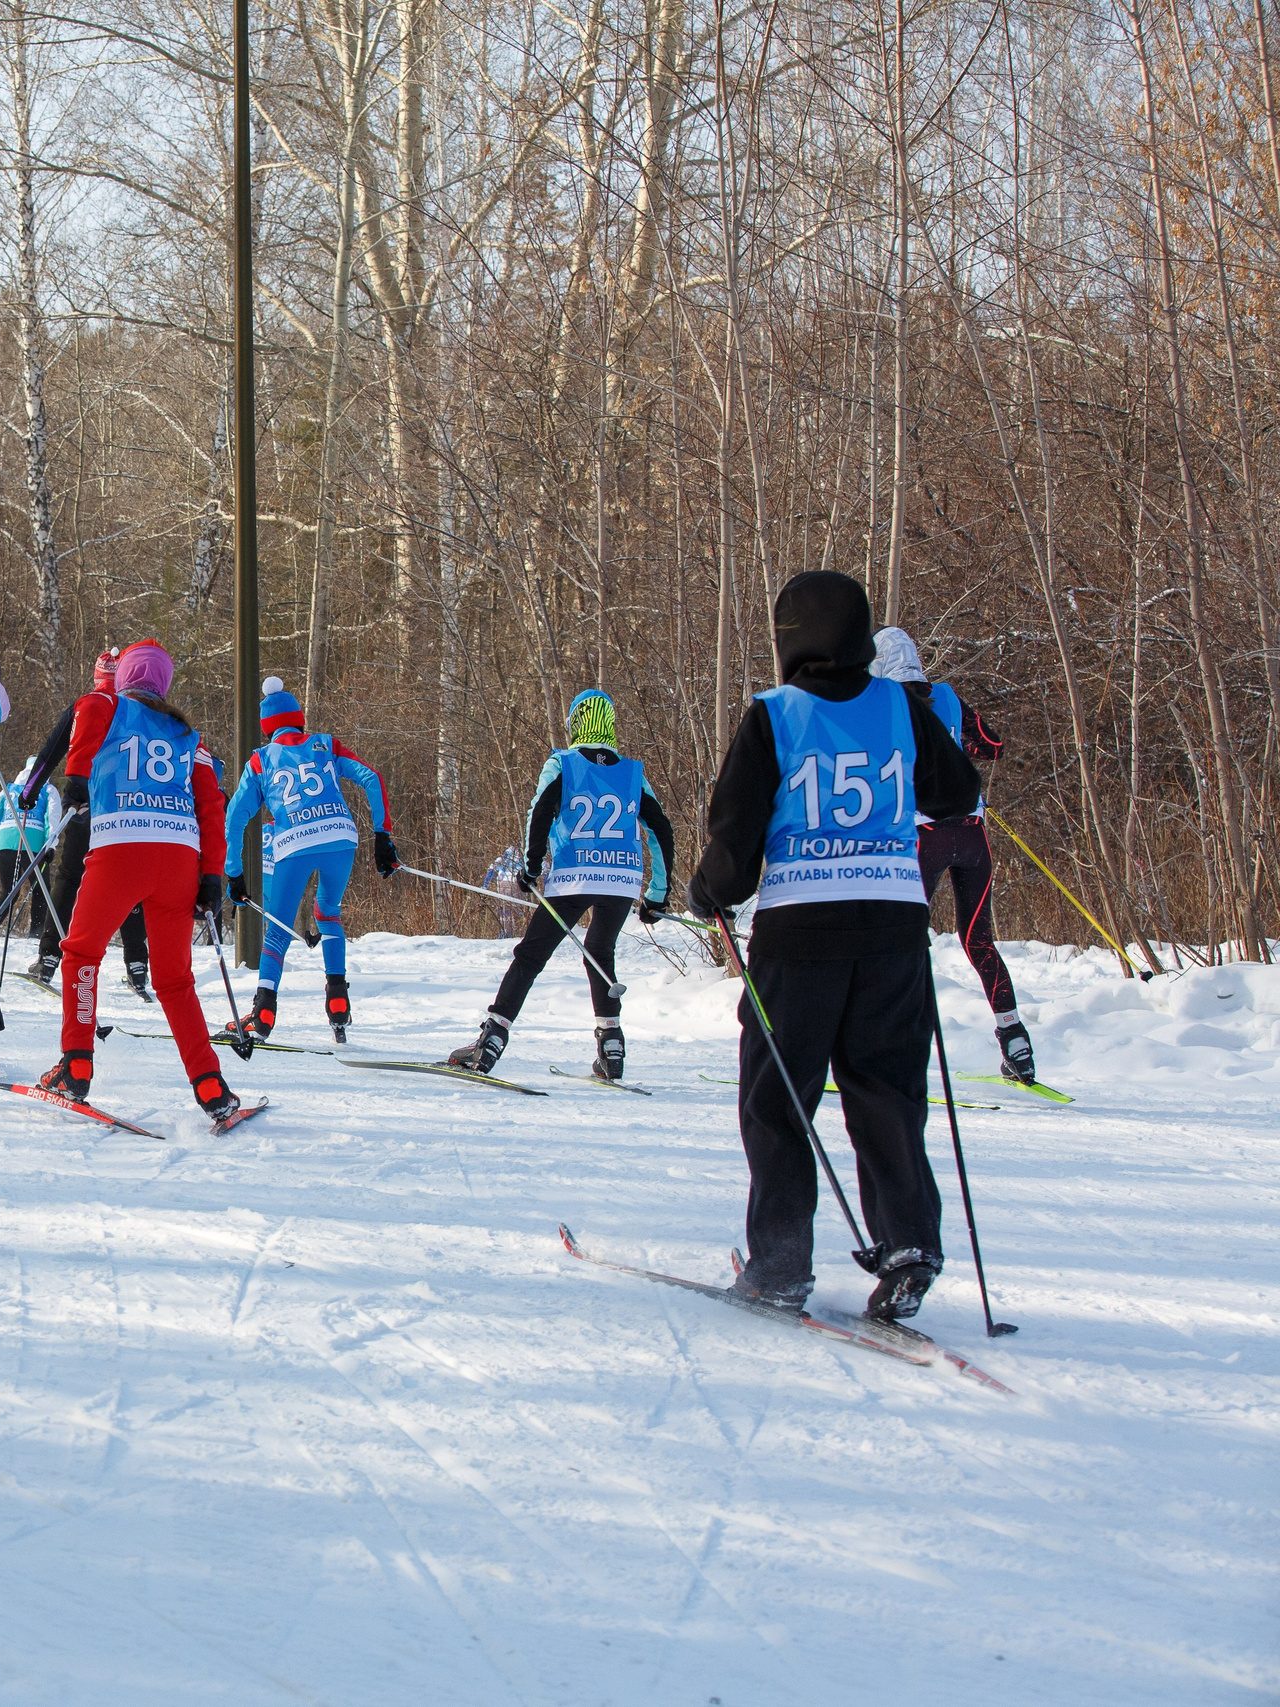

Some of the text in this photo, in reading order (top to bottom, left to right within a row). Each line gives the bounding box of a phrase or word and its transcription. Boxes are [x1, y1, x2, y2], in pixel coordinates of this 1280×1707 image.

[118, 734, 192, 794] 181
[273, 760, 340, 806] 251
[788, 749, 905, 831] 151
[115, 791, 192, 812] ТЮМЕНЬ
[287, 803, 348, 825] ТЮМЕНЬ
[569, 793, 641, 841] 221
[93, 821, 117, 834] КУБОК
[120, 819, 150, 828] ГЛАВЫ
[153, 819, 187, 832] ГОРОДА
[277, 834, 295, 848] КУБОК
[296, 827, 319, 839] ГЛАВЫ
[320, 822, 346, 833] ГОРОДА
[575, 849, 641, 867] ТЮМЕНЬ
[553, 873, 577, 884] КУБОК
[578, 873, 605, 882] ГЛАВЫ
[607, 873, 634, 885] ГОРОДА
[788, 868, 833, 882] ГЛАВЫ
[837, 866, 891, 881] ГОРОДА
[72, 965, 96, 1024] russia
[27, 1087, 74, 1109] PRO SKATE
